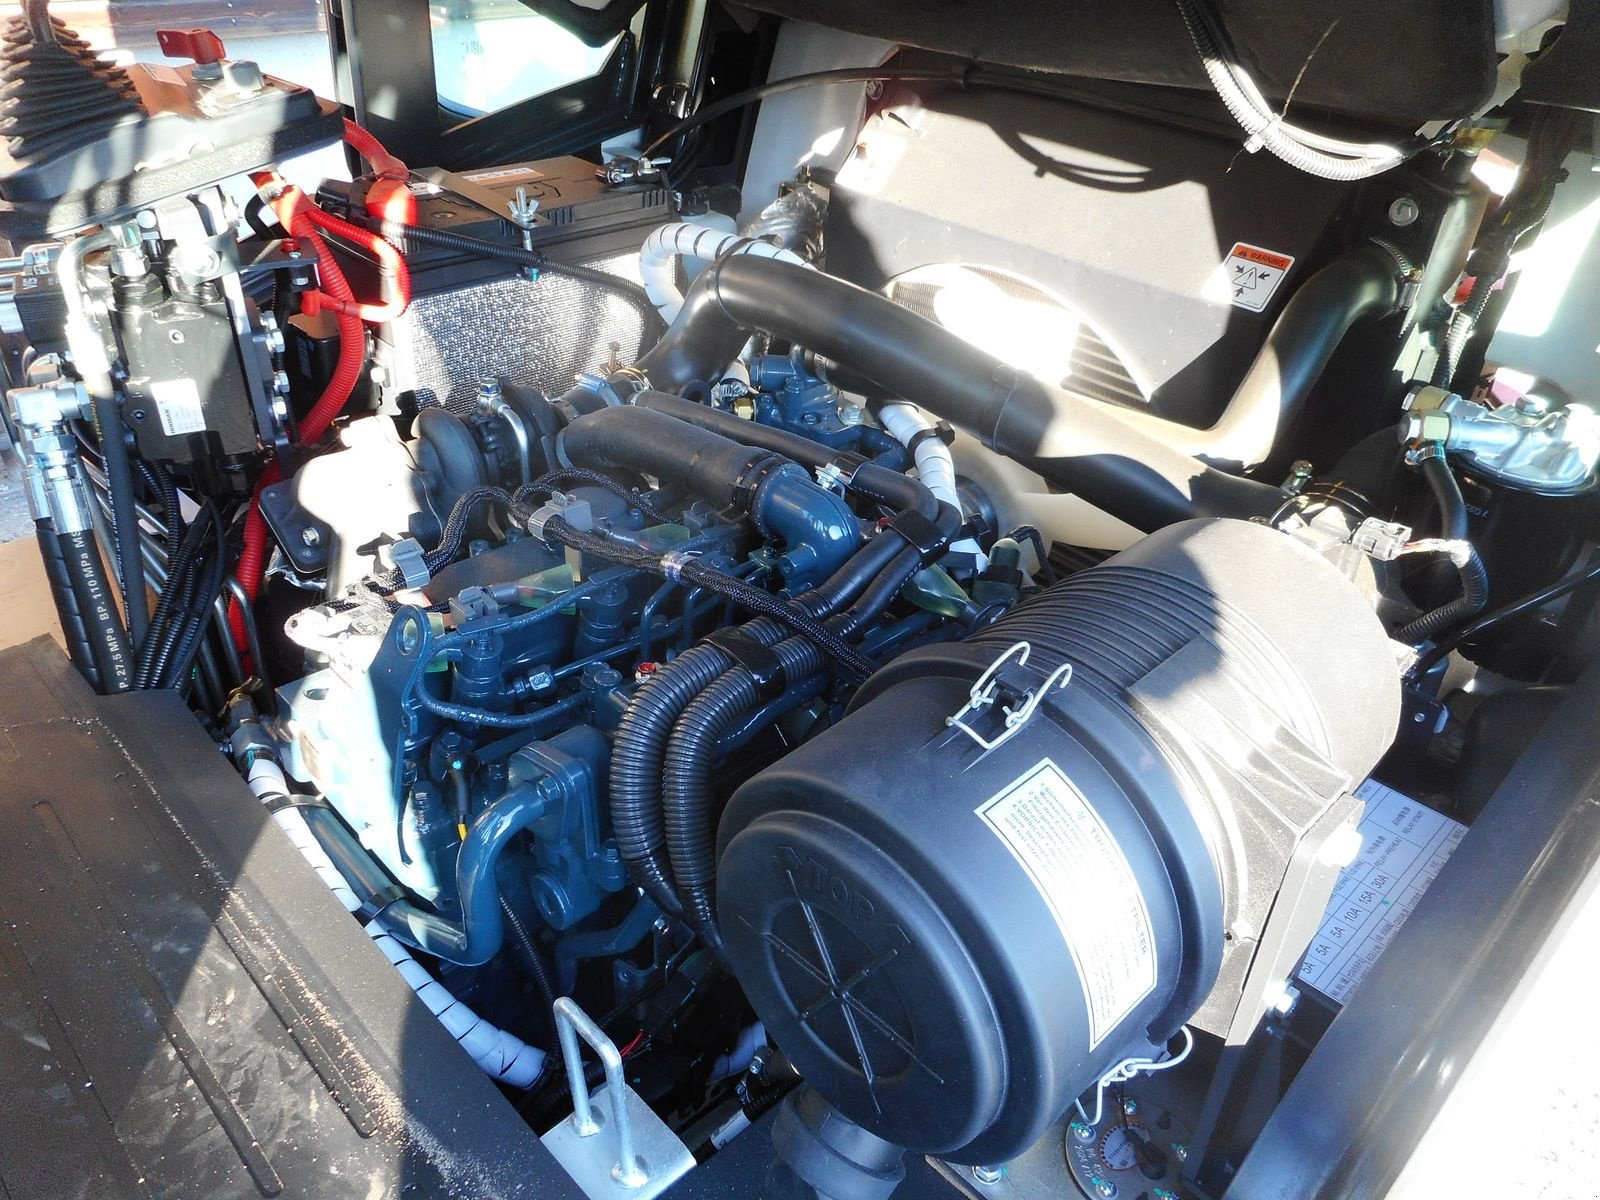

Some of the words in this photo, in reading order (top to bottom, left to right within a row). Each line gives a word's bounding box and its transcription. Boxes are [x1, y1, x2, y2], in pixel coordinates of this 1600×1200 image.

[1251, 251, 1284, 267] WARNING
[80, 552, 96, 579] MPa
[1315, 943, 1331, 957] 5A
[1330, 926, 1346, 939] 5A
[1344, 906, 1362, 922] 10A
[1358, 890, 1376, 905] 15A
[1371, 873, 1390, 889] 30A
